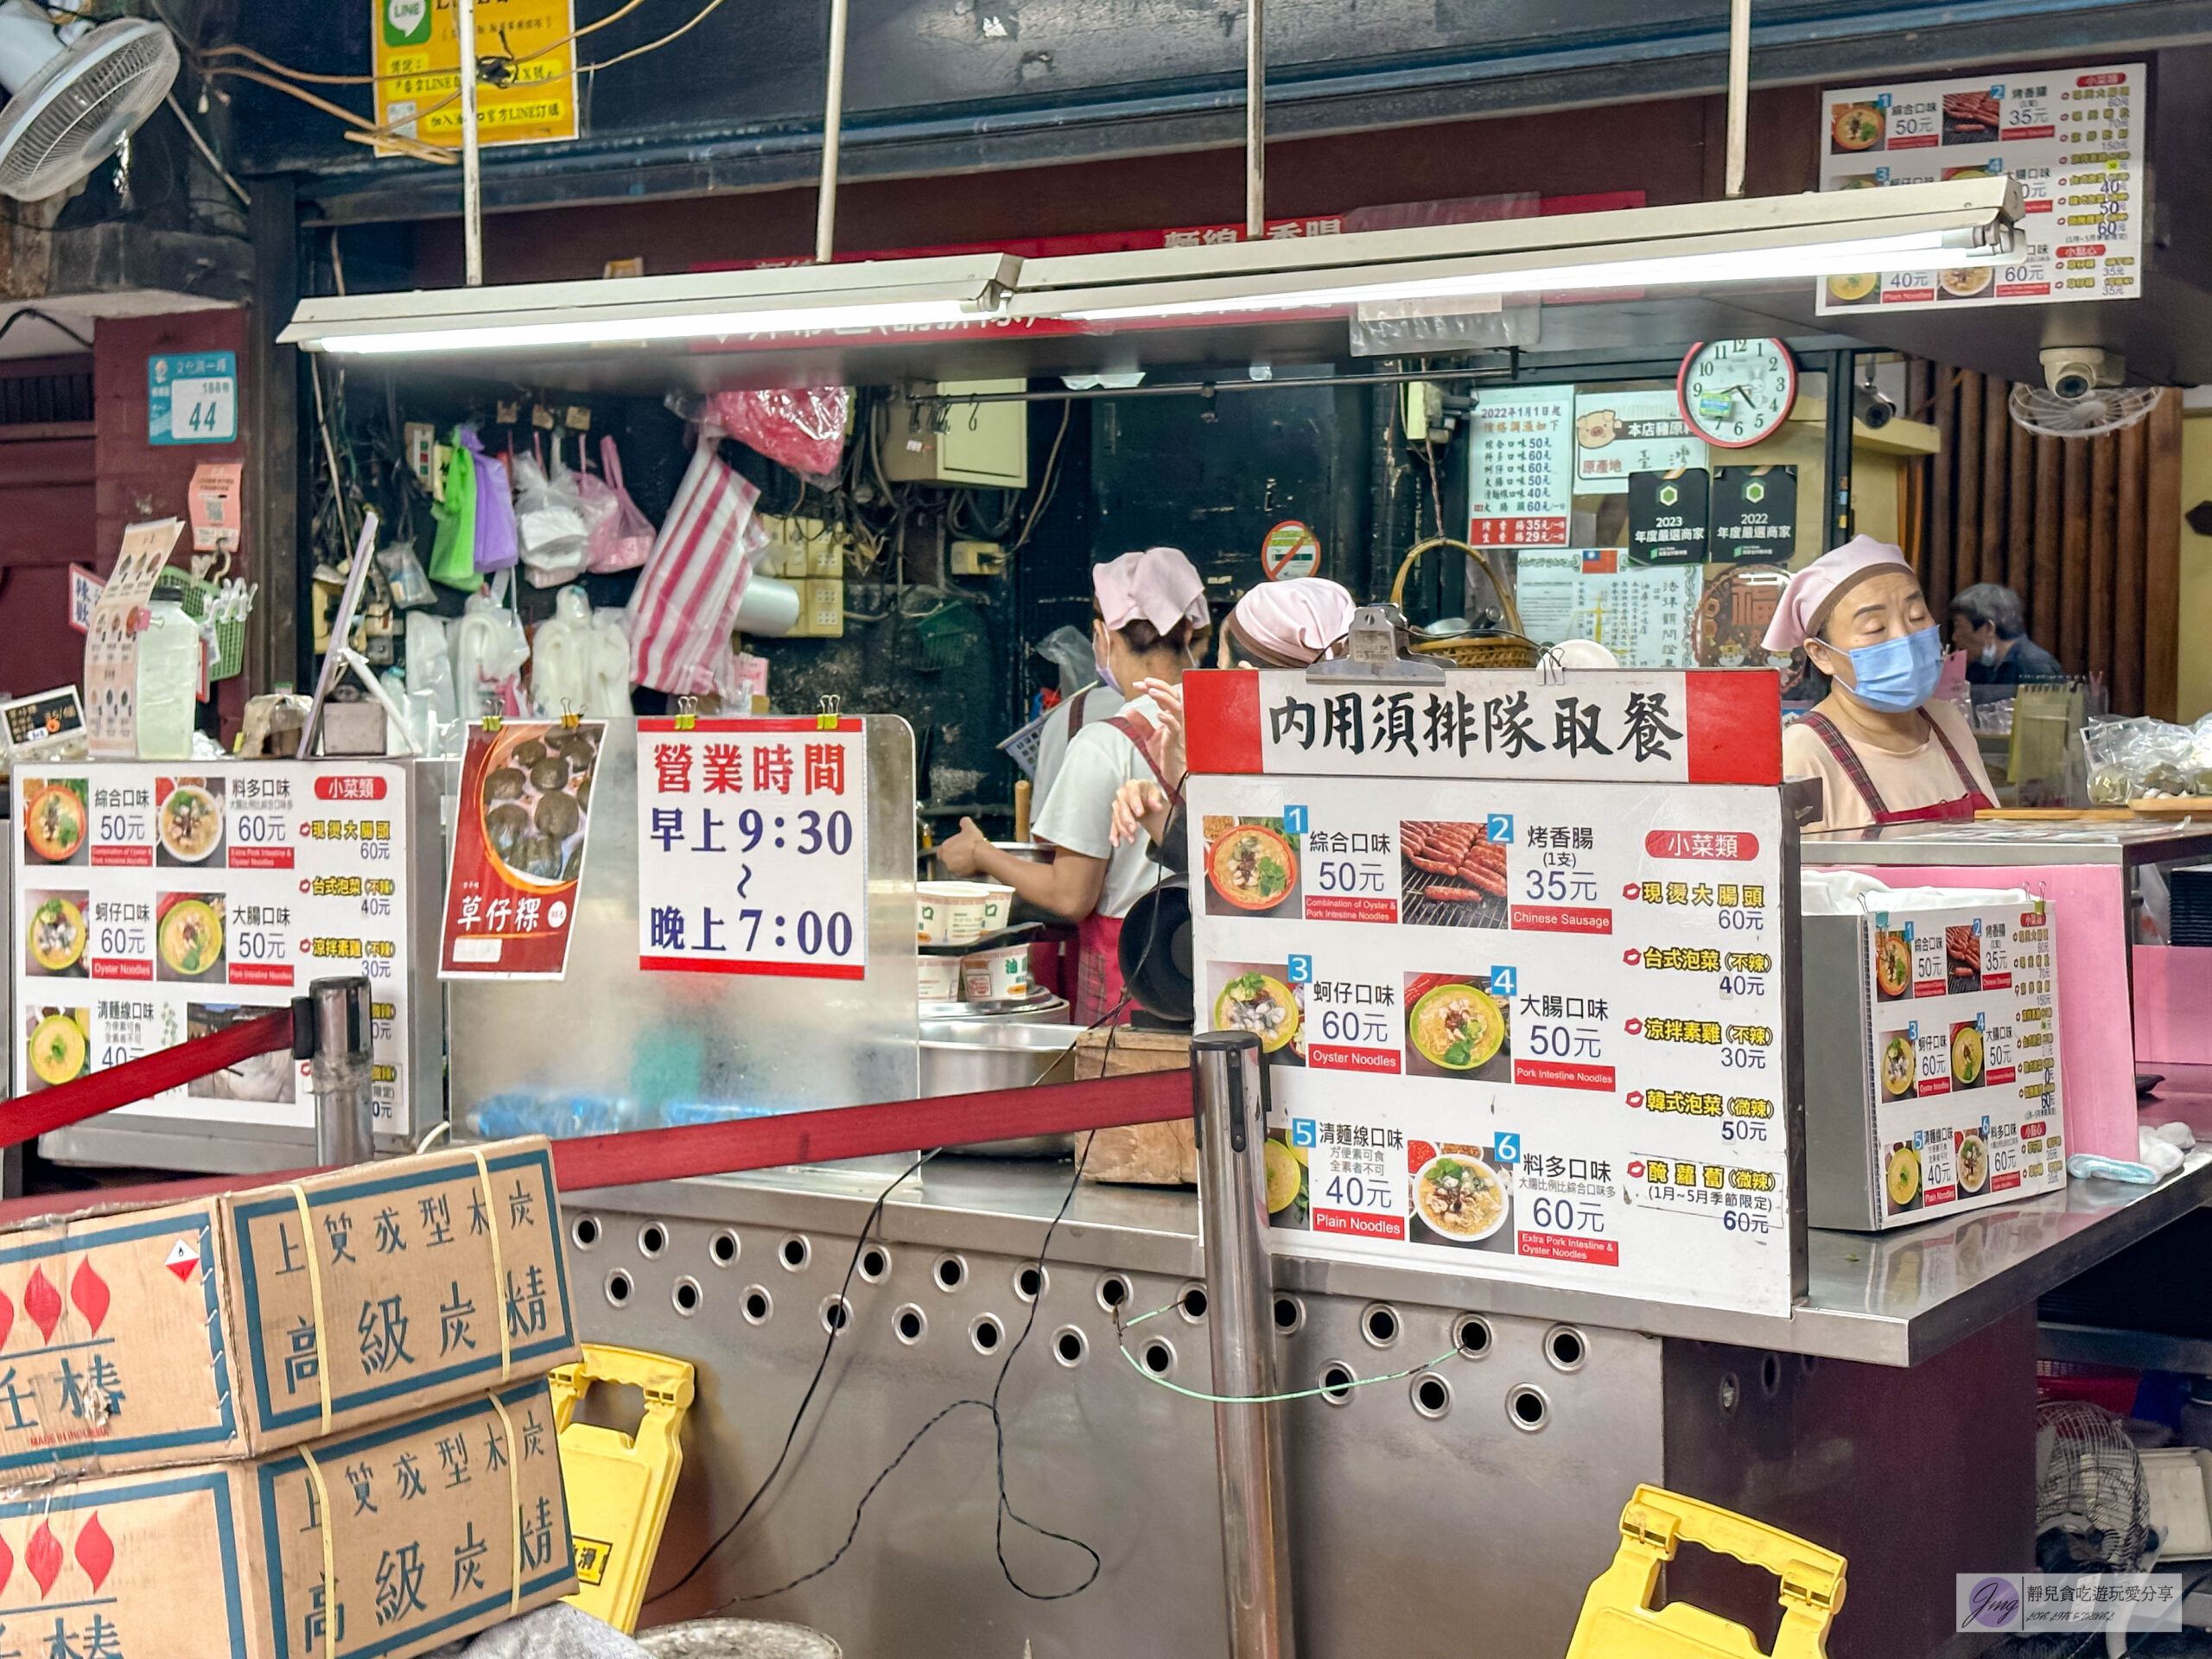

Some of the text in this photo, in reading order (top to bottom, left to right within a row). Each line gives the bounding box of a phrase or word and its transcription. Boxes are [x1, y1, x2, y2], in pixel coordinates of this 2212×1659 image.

[394, 3, 421, 18] LINE
[1993, 86, 2004, 99] 2
[1895, 118, 1934, 135] 50元
[2009, 108, 2048, 126] 35元
[1989, 159, 2001, 173] 4
[1890, 271, 1929, 288] 40元
[2005, 265, 2044, 283] 60元
[1714, 345, 1728, 360] 11
[1757, 342, 1764, 357] 1
[1700, 361, 1714, 377] 10
[1769, 357, 1778, 372] 2
[1693, 382, 1703, 397] 9
[1776, 377, 1786, 392] 3
[1481, 404, 1562, 419] 2022年1月1日起
[1769, 397, 1779, 412] 4
[188, 401, 217, 432] 44
[1754, 414, 1764, 429] 5
[1733, 421, 1744, 435] 6
[1656, 516, 1683, 528] 2023
[1740, 513, 1769, 525] 2022
[652, 743, 847, 797] 營業時間
[232, 779, 291, 798] 料多口味
[328, 778, 374, 798] 小菜類
[95, 788, 149, 809] 綜合口味
[100, 815, 146, 842] 50元
[238, 815, 287, 842] 60元
[1288, 806, 1303, 832] 1
[650, 806, 853, 856] 早上9:30
[1491, 817, 1509, 842] 2
[1527, 825, 1594, 851] 烤香腸
[360, 842, 391, 860] 60元
[1309, 830, 1392, 856] 綜合口味
[1667, 833, 1738, 859] 小菜類
[1542, 851, 1578, 868] (1支)
[1319, 861, 1384, 893] 50元
[1525, 868, 1598, 902] 35元
[1642, 881, 1765, 908] 現燙大腸頭
[95, 903, 150, 921] 蚵仔口味
[361, 898, 391, 915] 40元
[457, 895, 542, 933] 草仔粿
[1306, 898, 1396, 912] Combination of Oyster &
[232, 906, 291, 926] 大腸口味
[1306, 910, 1389, 922] Pork Intestine Noodles
[1513, 911, 1611, 930] Chinese Sausage
[1718, 909, 1764, 931] 60元
[650, 906, 853, 957] 晚上7:00
[1974, 918, 1981, 937] 2
[100, 928, 146, 954] 60元
[238, 931, 286, 959] 50元
[94, 962, 151, 976] Oyster Noodles
[361, 960, 391, 978] 30元
[1293, 957, 1307, 981] 3
[1917, 957, 1942, 978] 50元
[1986, 950, 2007, 971] 35元
[1492, 969, 1515, 994] 4
[1719, 976, 1765, 996] 40元
[1313, 982, 1395, 1007] 蚵仔口味
[98, 999, 155, 1020] 清麵線口味
[1520, 993, 1610, 1022] 大腸口味
[1321, 1010, 1389, 1043] 60元
[1910, 1021, 1917, 1039] 3
[1977, 1013, 1985, 1032] 4
[1529, 1025, 1603, 1059] 50元
[1313, 1050, 1397, 1069] Oyster Noodles
[1720, 1046, 1766, 1069] 30元
[1922, 1053, 1947, 1077] 60元
[1990, 1044, 2012, 1066] 50元
[1516, 1066, 1613, 1086] Pork Intestine Noodles
[1297, 1122, 1312, 1147] 5
[1721, 1120, 1767, 1141] 50元
[1981, 1117, 1989, 1134] 6
[1319, 1122, 1405, 1151] 清麵線口味
[1915, 1131, 1923, 1150] 5
[1330, 1146, 1385, 1162] 方便素可食
[1499, 1135, 1516, 1160] 6
[1330, 1160, 1385, 1177] 全素者不可
[1522, 1154, 1612, 1184] 料多口味
[1994, 1148, 2017, 1172] 60元
[1928, 1162, 1951, 1185] 40元
[1325, 1176, 1393, 1210] 40元
[1316, 1213, 1402, 1236] Plain Noodles
[1532, 1197, 1605, 1234] 60元
[1723, 1210, 1769, 1235] 60元
[1522, 1233, 1614, 1251] Extra Pork Intestine &
[1522, 1244, 1588, 1261] Oyster Noodles
[284, 1264, 548, 1395] 高級炭精
[30, 1434, 56, 1447] MADE
